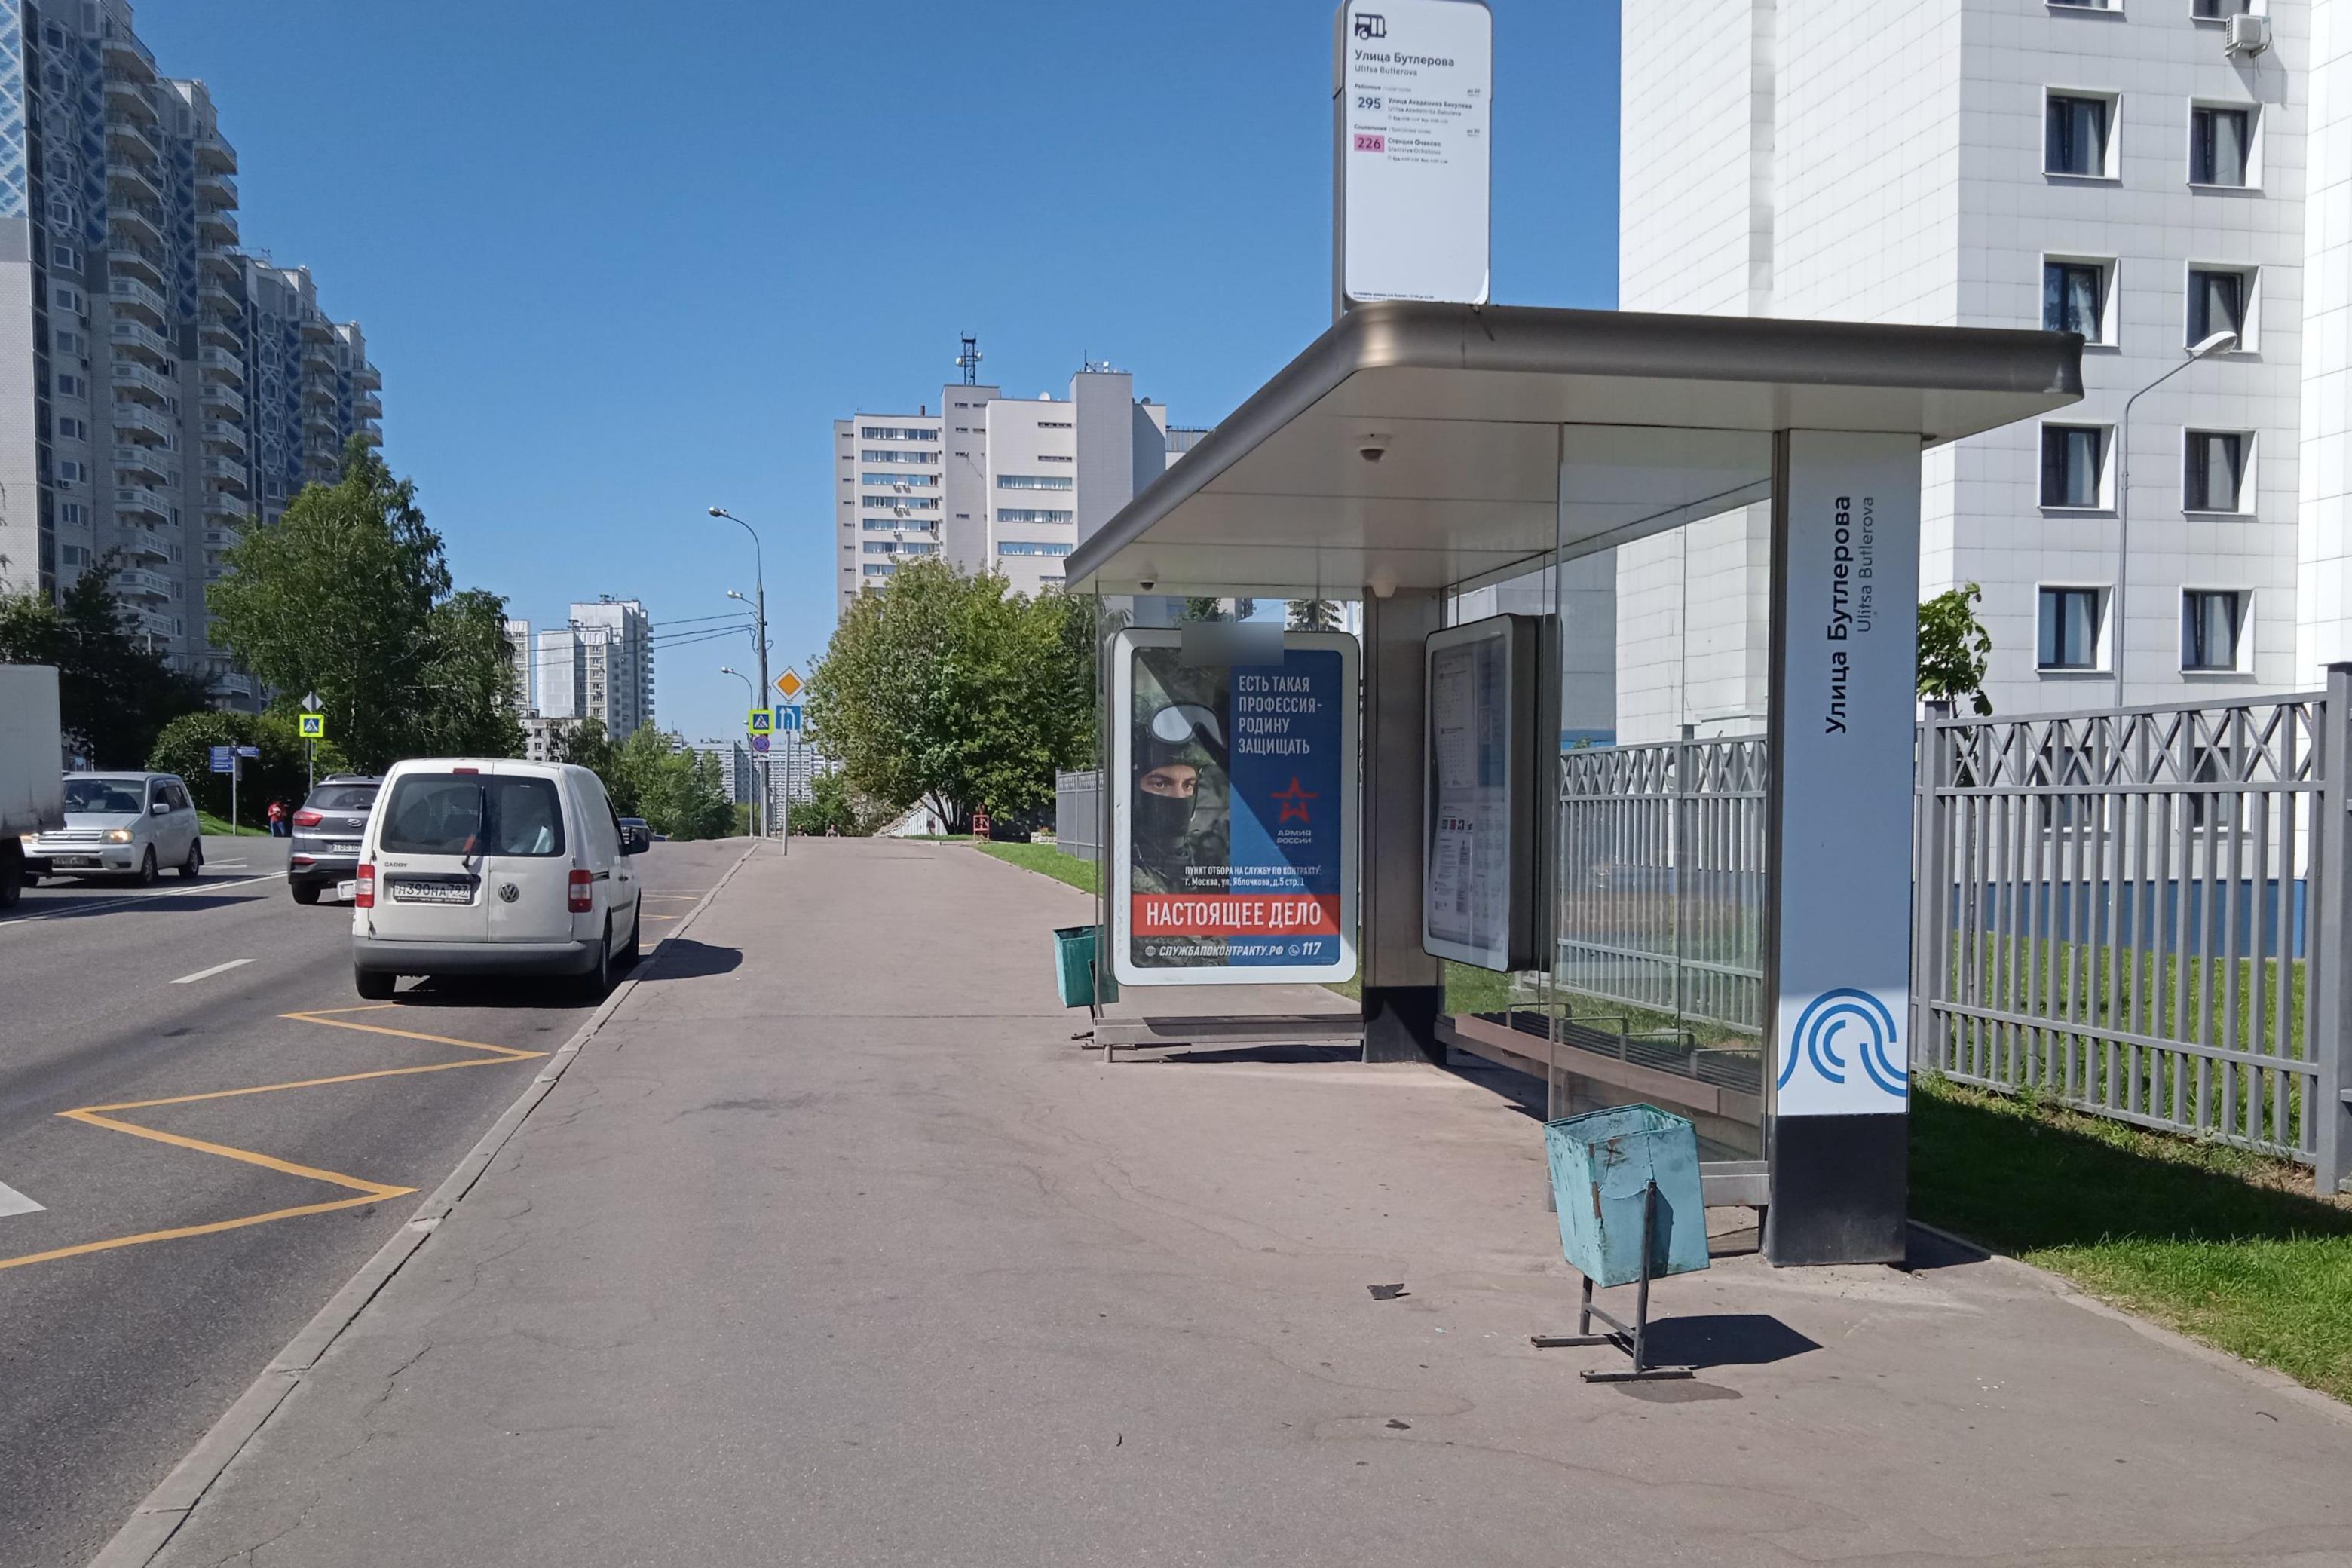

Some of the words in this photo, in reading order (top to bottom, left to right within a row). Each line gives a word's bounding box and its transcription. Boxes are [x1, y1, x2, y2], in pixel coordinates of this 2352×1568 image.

[1355, 49, 1391, 63] Улица
[1394, 52, 1455, 68] Бутлерова
[1355, 65, 1378, 74] Ulitsa
[1380, 66, 1417, 76] Butlerova
[1358, 96, 1381, 109] 295
[1358, 137, 1381, 149] 226
[1858, 497, 1874, 579] Butlerova
[1827, 496, 1854, 641] Бутлерова
[1857, 585, 1872, 632] Ulitsa
[1239, 675, 1269, 691] ЕСТЬ
[1272, 677, 1310, 692] ТАКАЯ
[1825, 651, 1850, 734] Улица
[1239, 717, 1290, 735] РОДИНУ
[1238, 738, 1310, 755] ЗАЩИЩАТЬ
[1185, 866, 1207, 876] ПУНКТ
[1208, 866, 1233, 876] ОТБОРА
[1234, 867, 1244, 876] НА
[1245, 866, 1272, 876] СЛУЖБУ
[1272, 866, 1282, 876] ПО
[1192, 877, 1220, 888] Москва,
[1221, 878, 1232, 889] ул.
[1285, 879, 1300, 889] стр.
[1300, 877, 1305, 887] 1
[1146, 902, 1264, 928] НАСТОЯЩЕЕ
[1268, 902, 1321, 929] ДЕЛО
[1159, 945, 1284, 957] СЛУЖБАПОКОНТРАКТУ.РФ
[1302, 942, 1322, 956] 117
